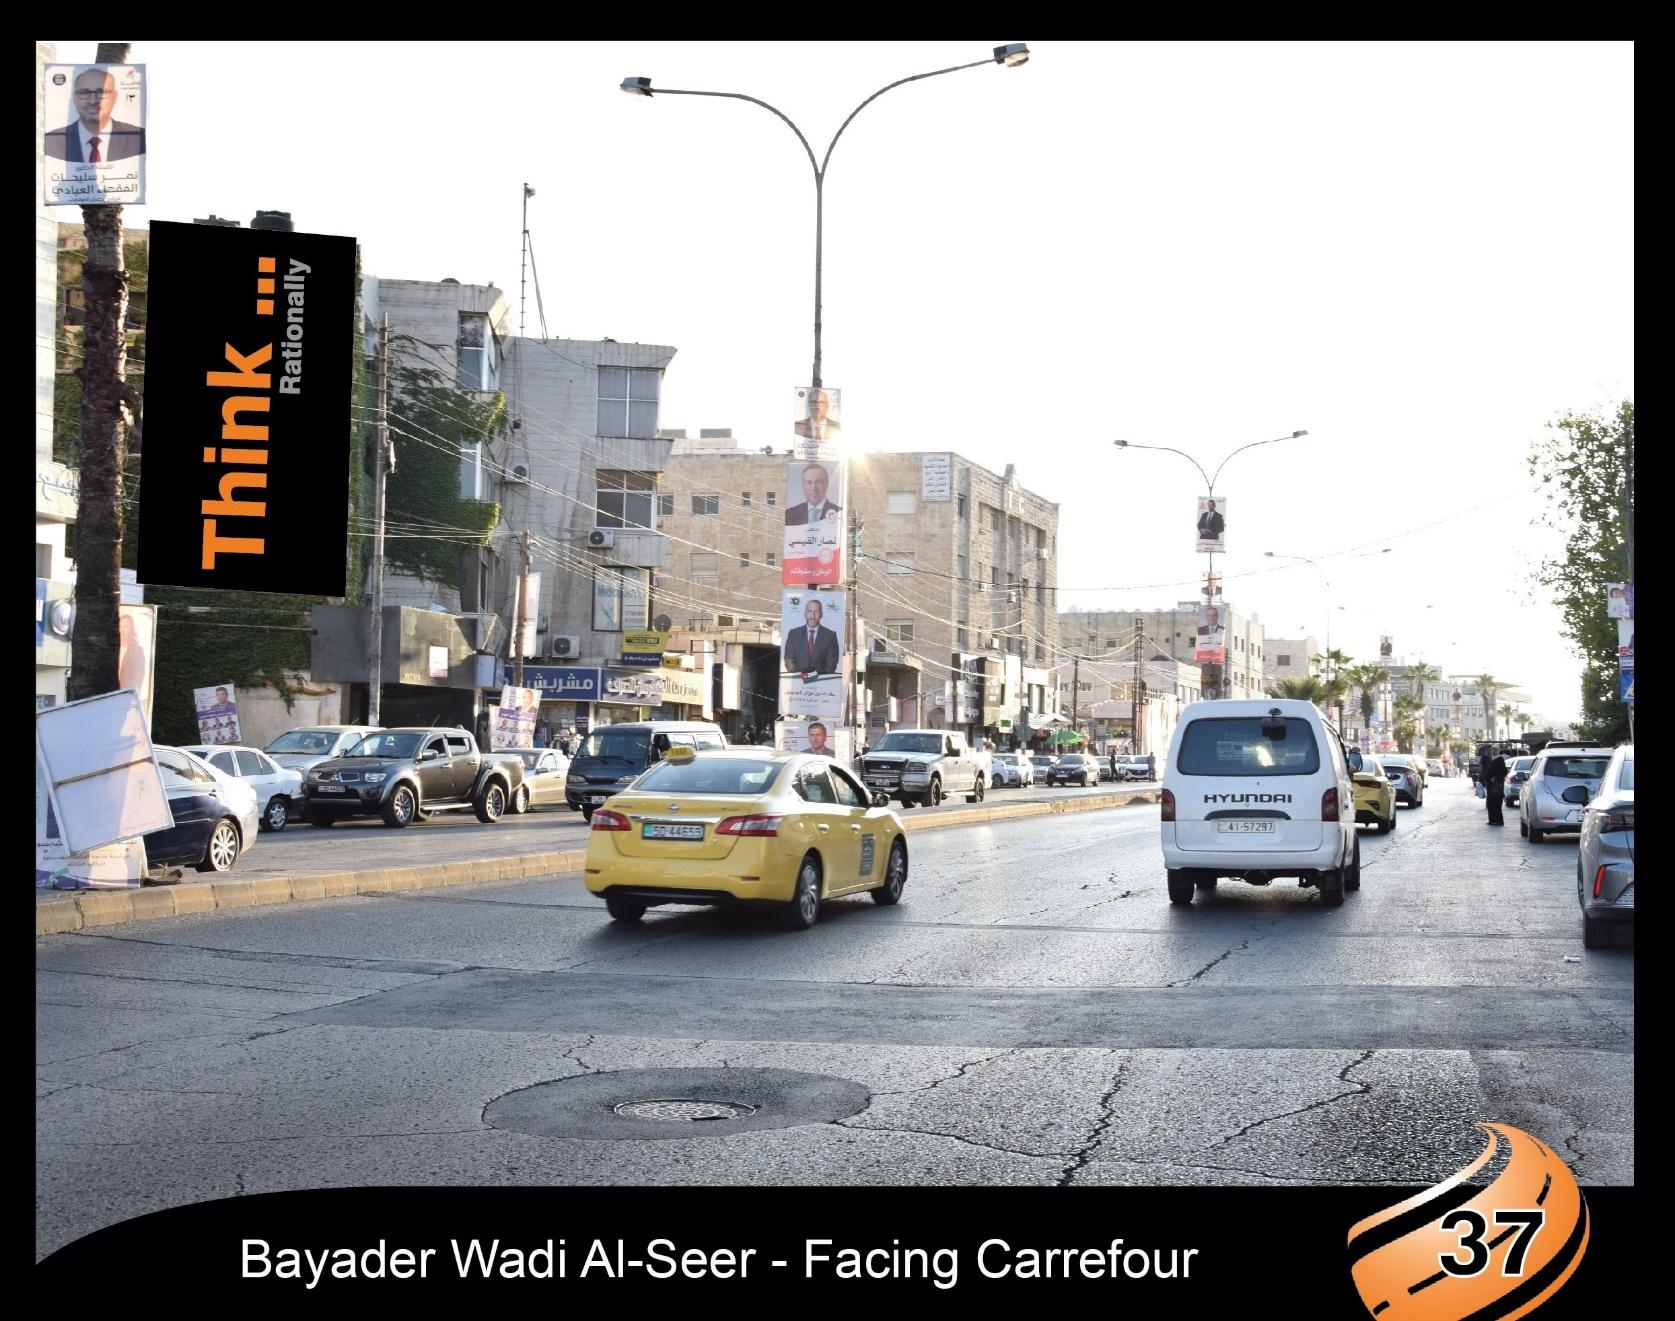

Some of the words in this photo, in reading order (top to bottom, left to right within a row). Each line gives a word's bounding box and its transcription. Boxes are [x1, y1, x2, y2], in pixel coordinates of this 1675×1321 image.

[100, 171, 138, 183] نمر
[279, 258, 312, 395] Rationally
[201, 342, 273, 570] Think
[1204, 793, 1293, 804] HYUNDAI
